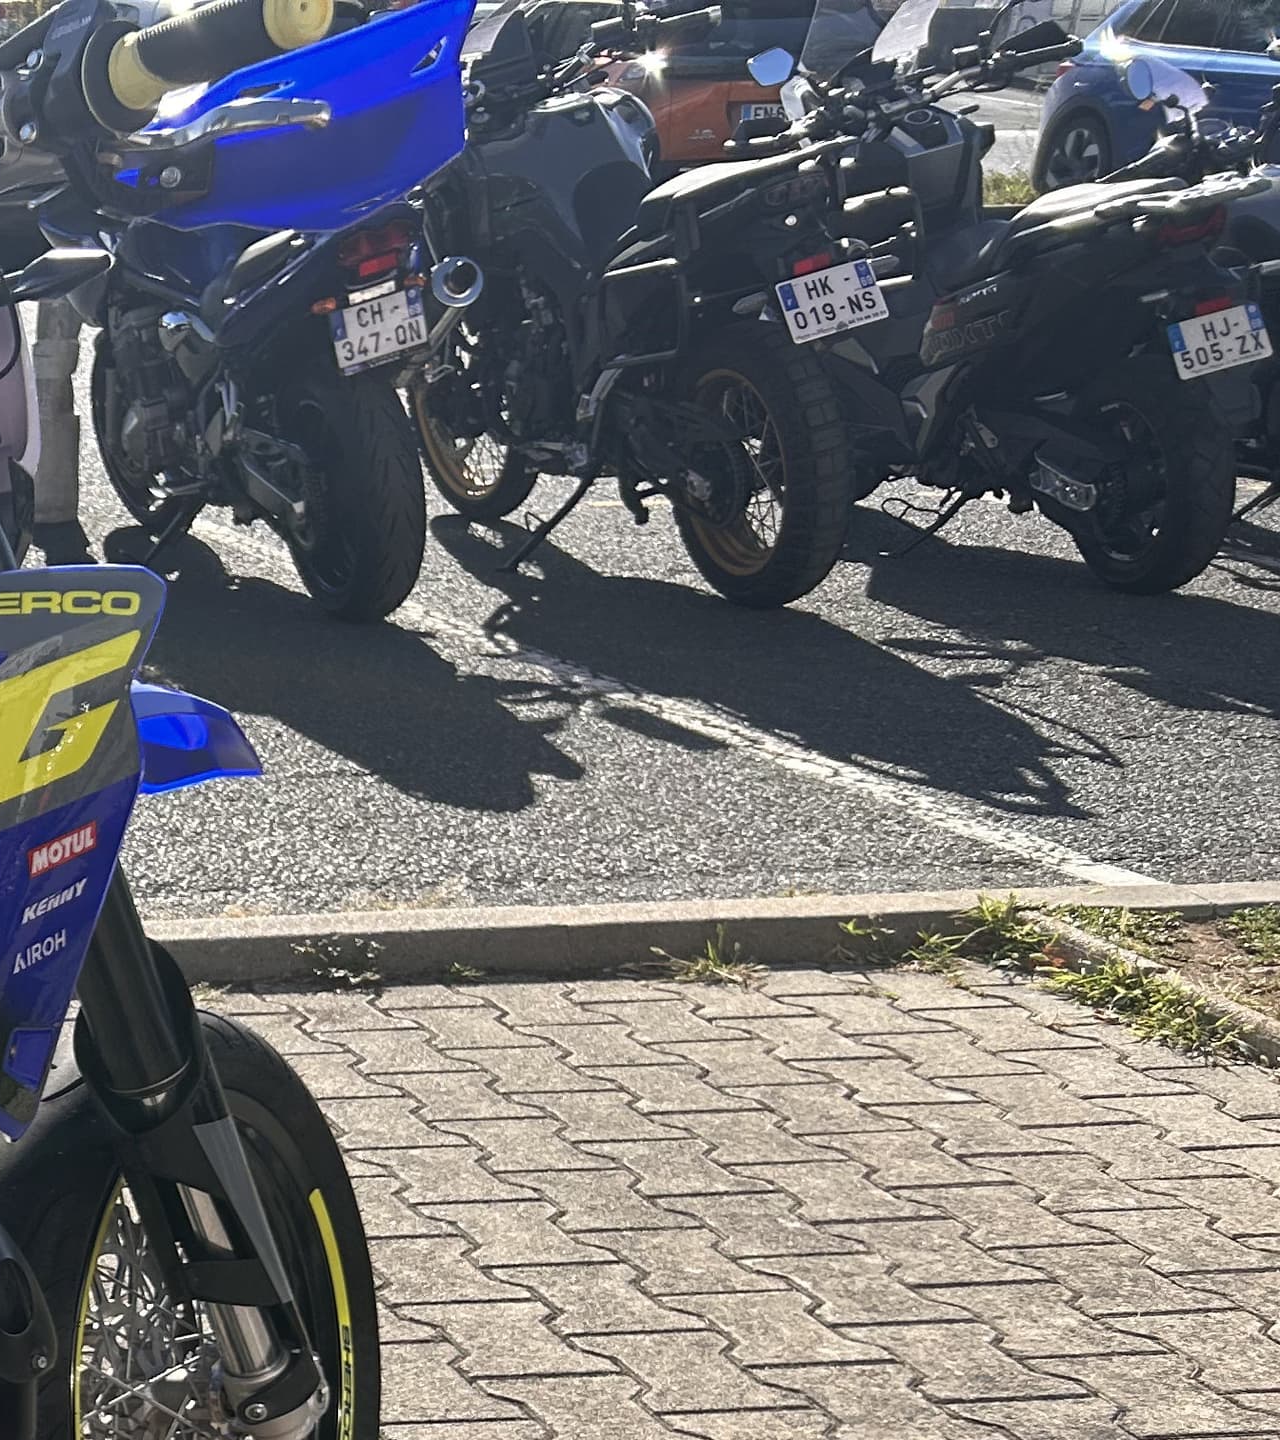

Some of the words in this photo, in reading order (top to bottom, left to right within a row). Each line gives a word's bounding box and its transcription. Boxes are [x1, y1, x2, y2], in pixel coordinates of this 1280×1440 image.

[793, 291, 877, 330] 019-NS
[1180, 331, 1265, 370] 505-ZX
[30, 826, 95, 875] MOTUL
[21, 877, 88, 925] KENNY
[12, 928, 67, 975] AIROH
